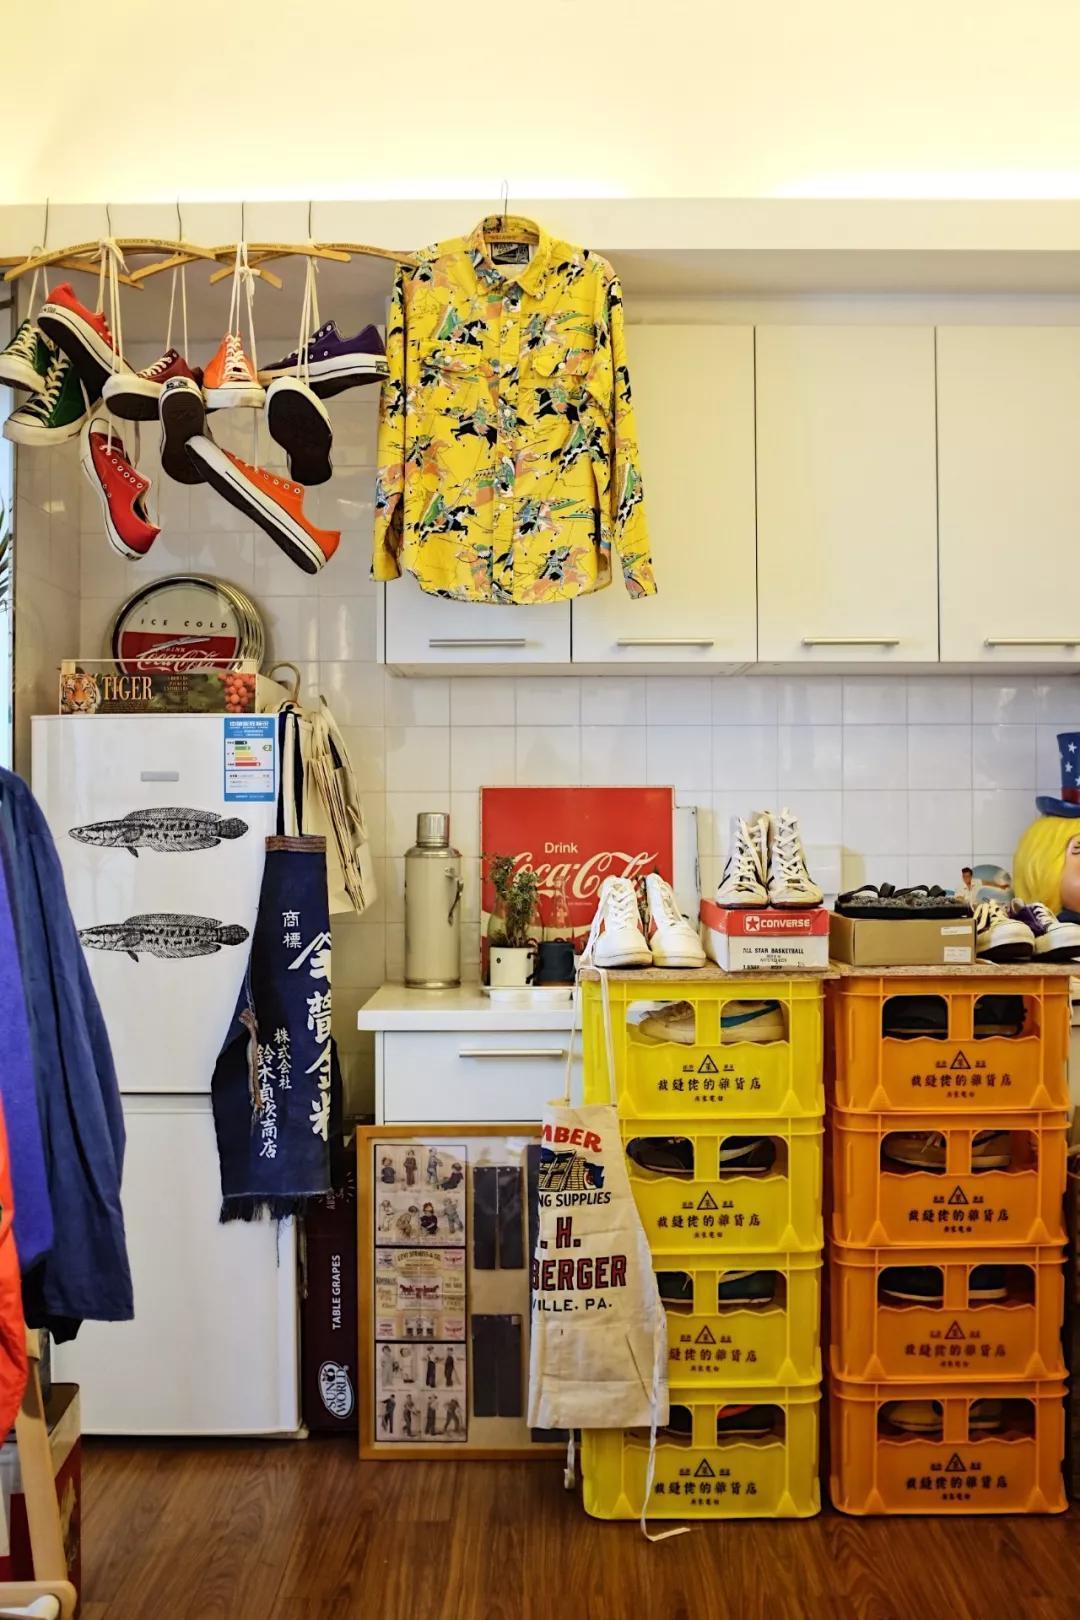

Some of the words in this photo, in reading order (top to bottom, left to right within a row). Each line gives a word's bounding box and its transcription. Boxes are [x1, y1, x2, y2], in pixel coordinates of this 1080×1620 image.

[184, 620, 227, 629] COLD
[102, 676, 153, 701] TIGER
[544, 842, 578, 853] Drink
[281, 909, 302, 949] 商標
[760, 918, 811, 929] CONVERSE
[273, 1027, 293, 1091] 株式会社
[556, 1191, 612, 1207] SUPPLIES
[332, 1254, 341, 1296] GRAPES
[332, 1297, 341, 1330] TABLE
[585, 1297, 612, 1310] PA.
[326, 1382, 336, 1408] SUN
[336, 1369, 346, 1412] WORLD
